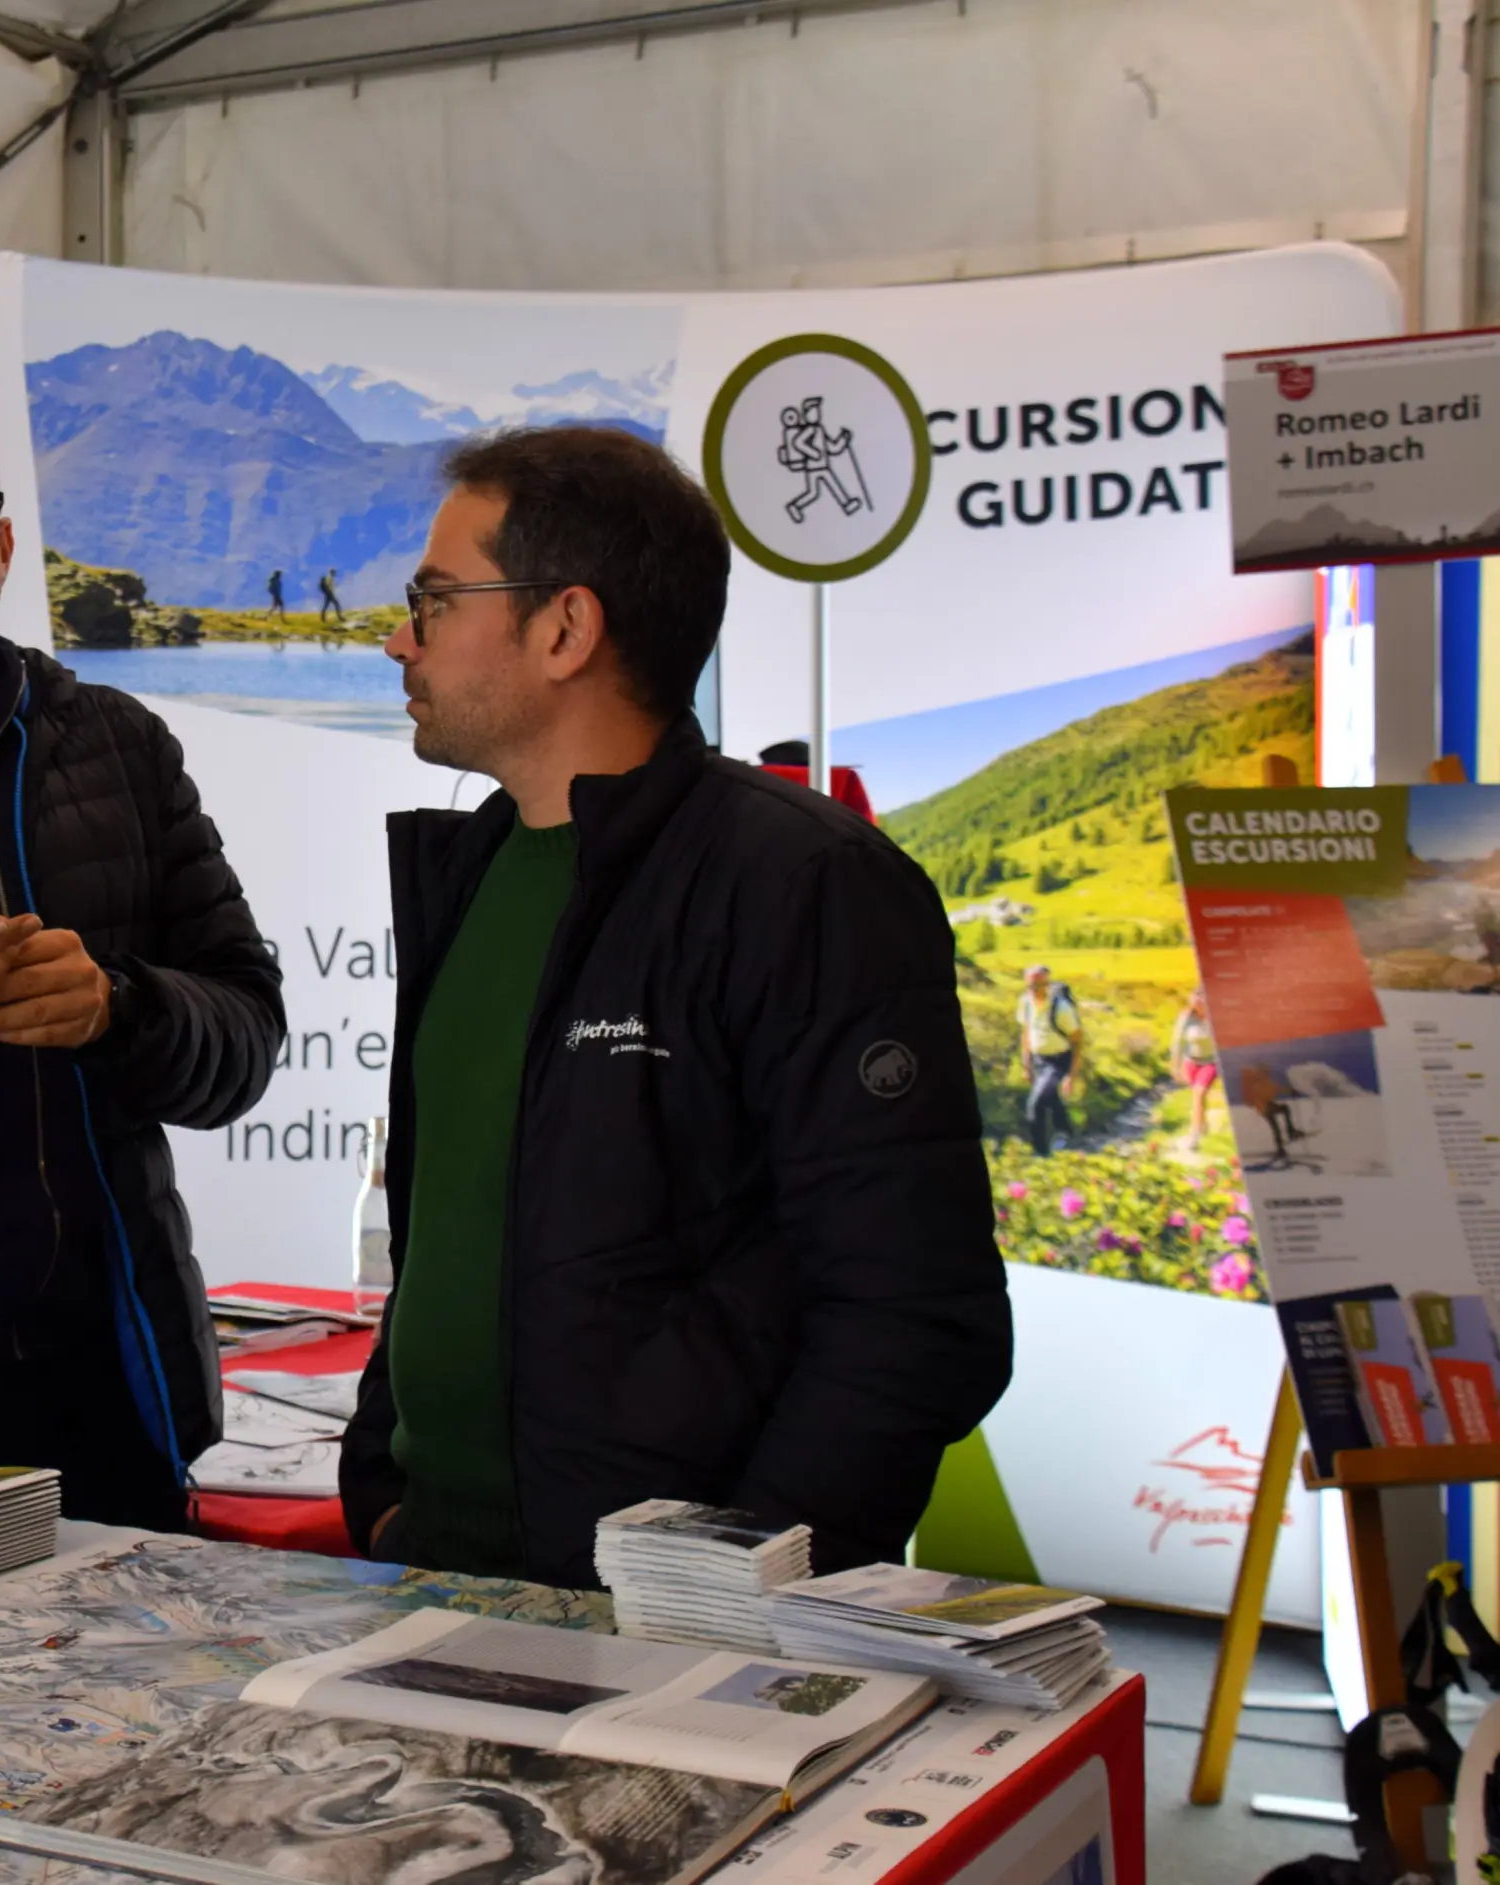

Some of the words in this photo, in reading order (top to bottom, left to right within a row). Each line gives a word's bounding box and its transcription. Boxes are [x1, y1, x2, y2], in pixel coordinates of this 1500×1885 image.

[1276, 407, 1389, 438] Romeo
[1400, 393, 1481, 426] Lardi
[1305, 436, 1424, 470] Imbach
[1185, 808, 1382, 836] CALENDARIO
[1190, 837, 1377, 865] ESCURSIONI
